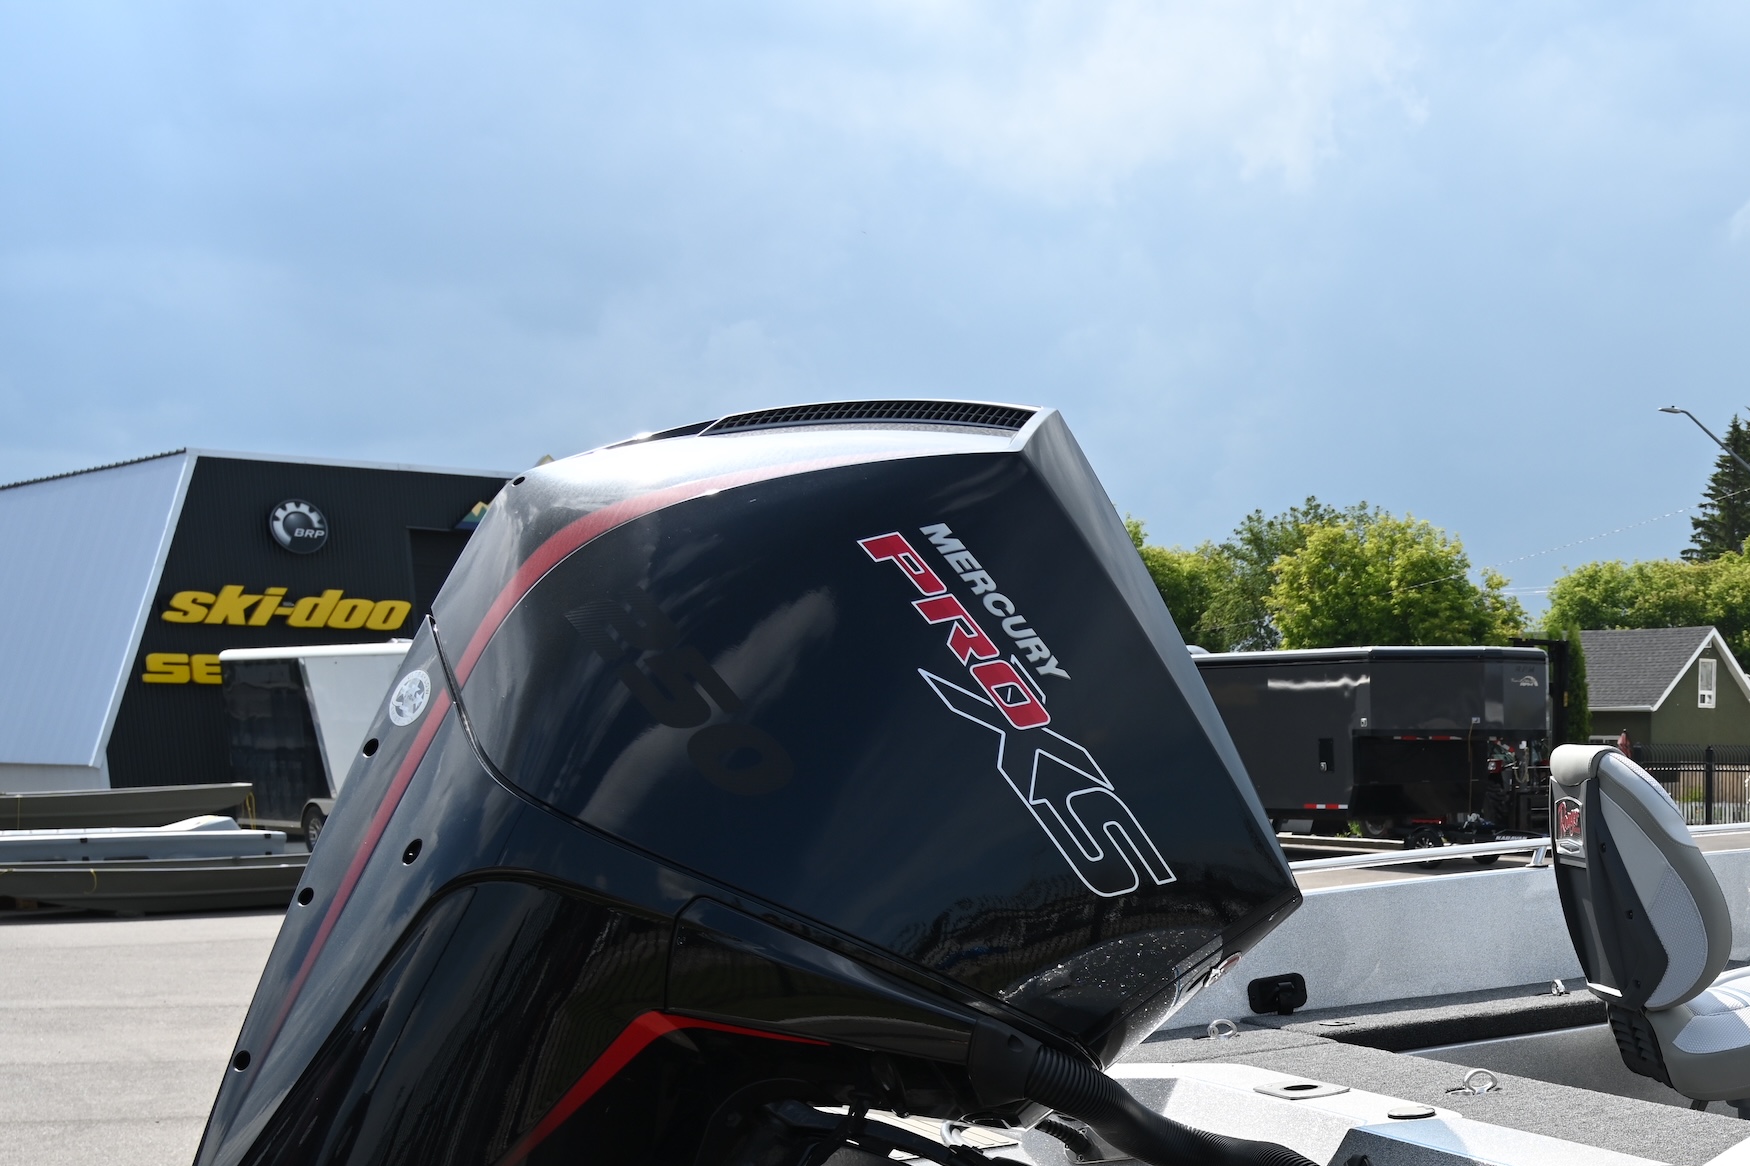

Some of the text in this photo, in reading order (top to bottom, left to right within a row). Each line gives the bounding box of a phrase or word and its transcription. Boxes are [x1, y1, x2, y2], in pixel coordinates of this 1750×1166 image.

[294, 527, 325, 539] BRP
[161, 584, 412, 631] ski-doo
[920, 522, 1072, 681] MERCURY
[856, 531, 1178, 898] PRO XS
